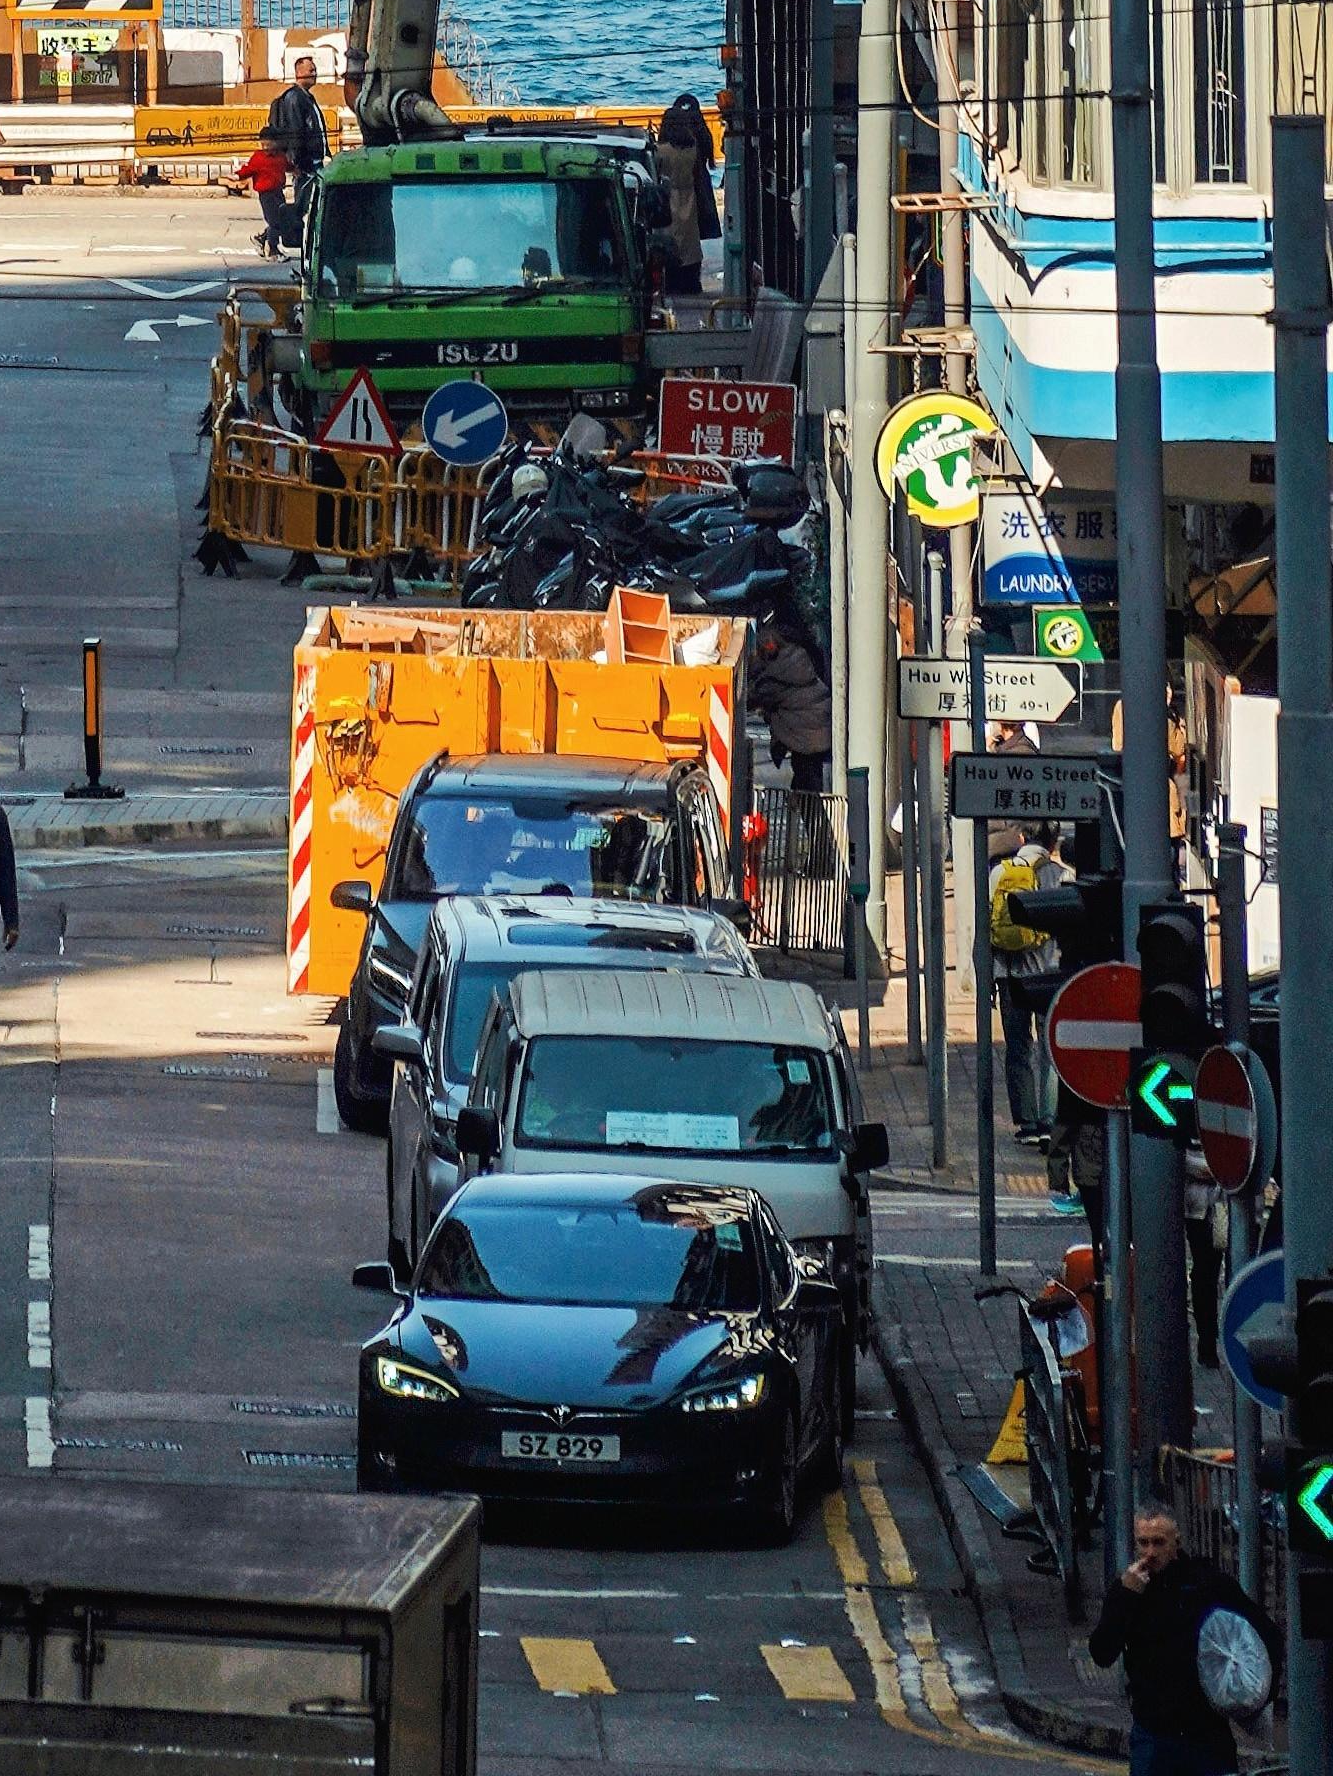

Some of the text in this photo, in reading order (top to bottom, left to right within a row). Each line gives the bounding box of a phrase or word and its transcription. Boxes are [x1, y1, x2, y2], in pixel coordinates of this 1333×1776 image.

[688, 388, 770, 414] SLOW
[1001, 510, 1118, 540] 洗衣服
[999, 573, 1074, 594] LAUNDRY
[909, 668, 941, 684] Hau
[983, 671, 1036, 686] Street
[1019, 700, 1050, 712] 49-1
[965, 766, 1097, 781] Hau Wo Street
[994, 789, 1067, 811] 厚和街
[518, 1435, 604, 1458] SZ 829
